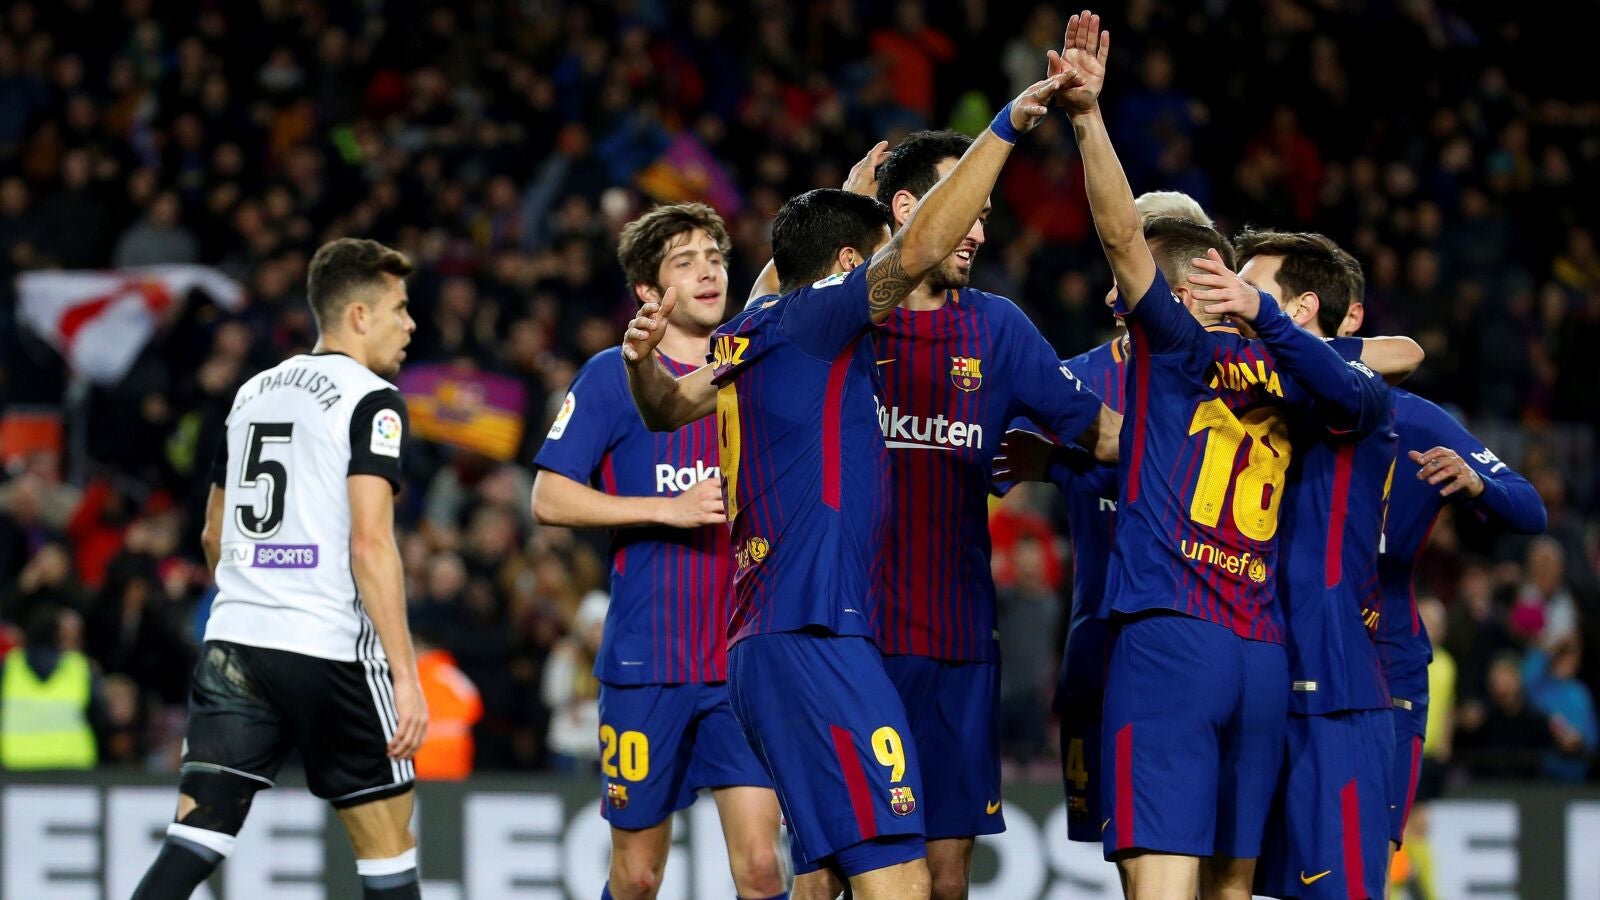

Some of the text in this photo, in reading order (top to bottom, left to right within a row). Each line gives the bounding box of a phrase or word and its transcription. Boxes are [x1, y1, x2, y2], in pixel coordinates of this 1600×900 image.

[259, 367, 341, 412] PAULISTA
[873, 395, 983, 449] akuten
[234, 422, 294, 540] 5
[1188, 396, 1293, 542] 18
[258, 547, 314, 566] SPORTS
[1181, 540, 1251, 576] unicef
[601, 725, 649, 782] 20
[871, 726, 906, 783] 9
